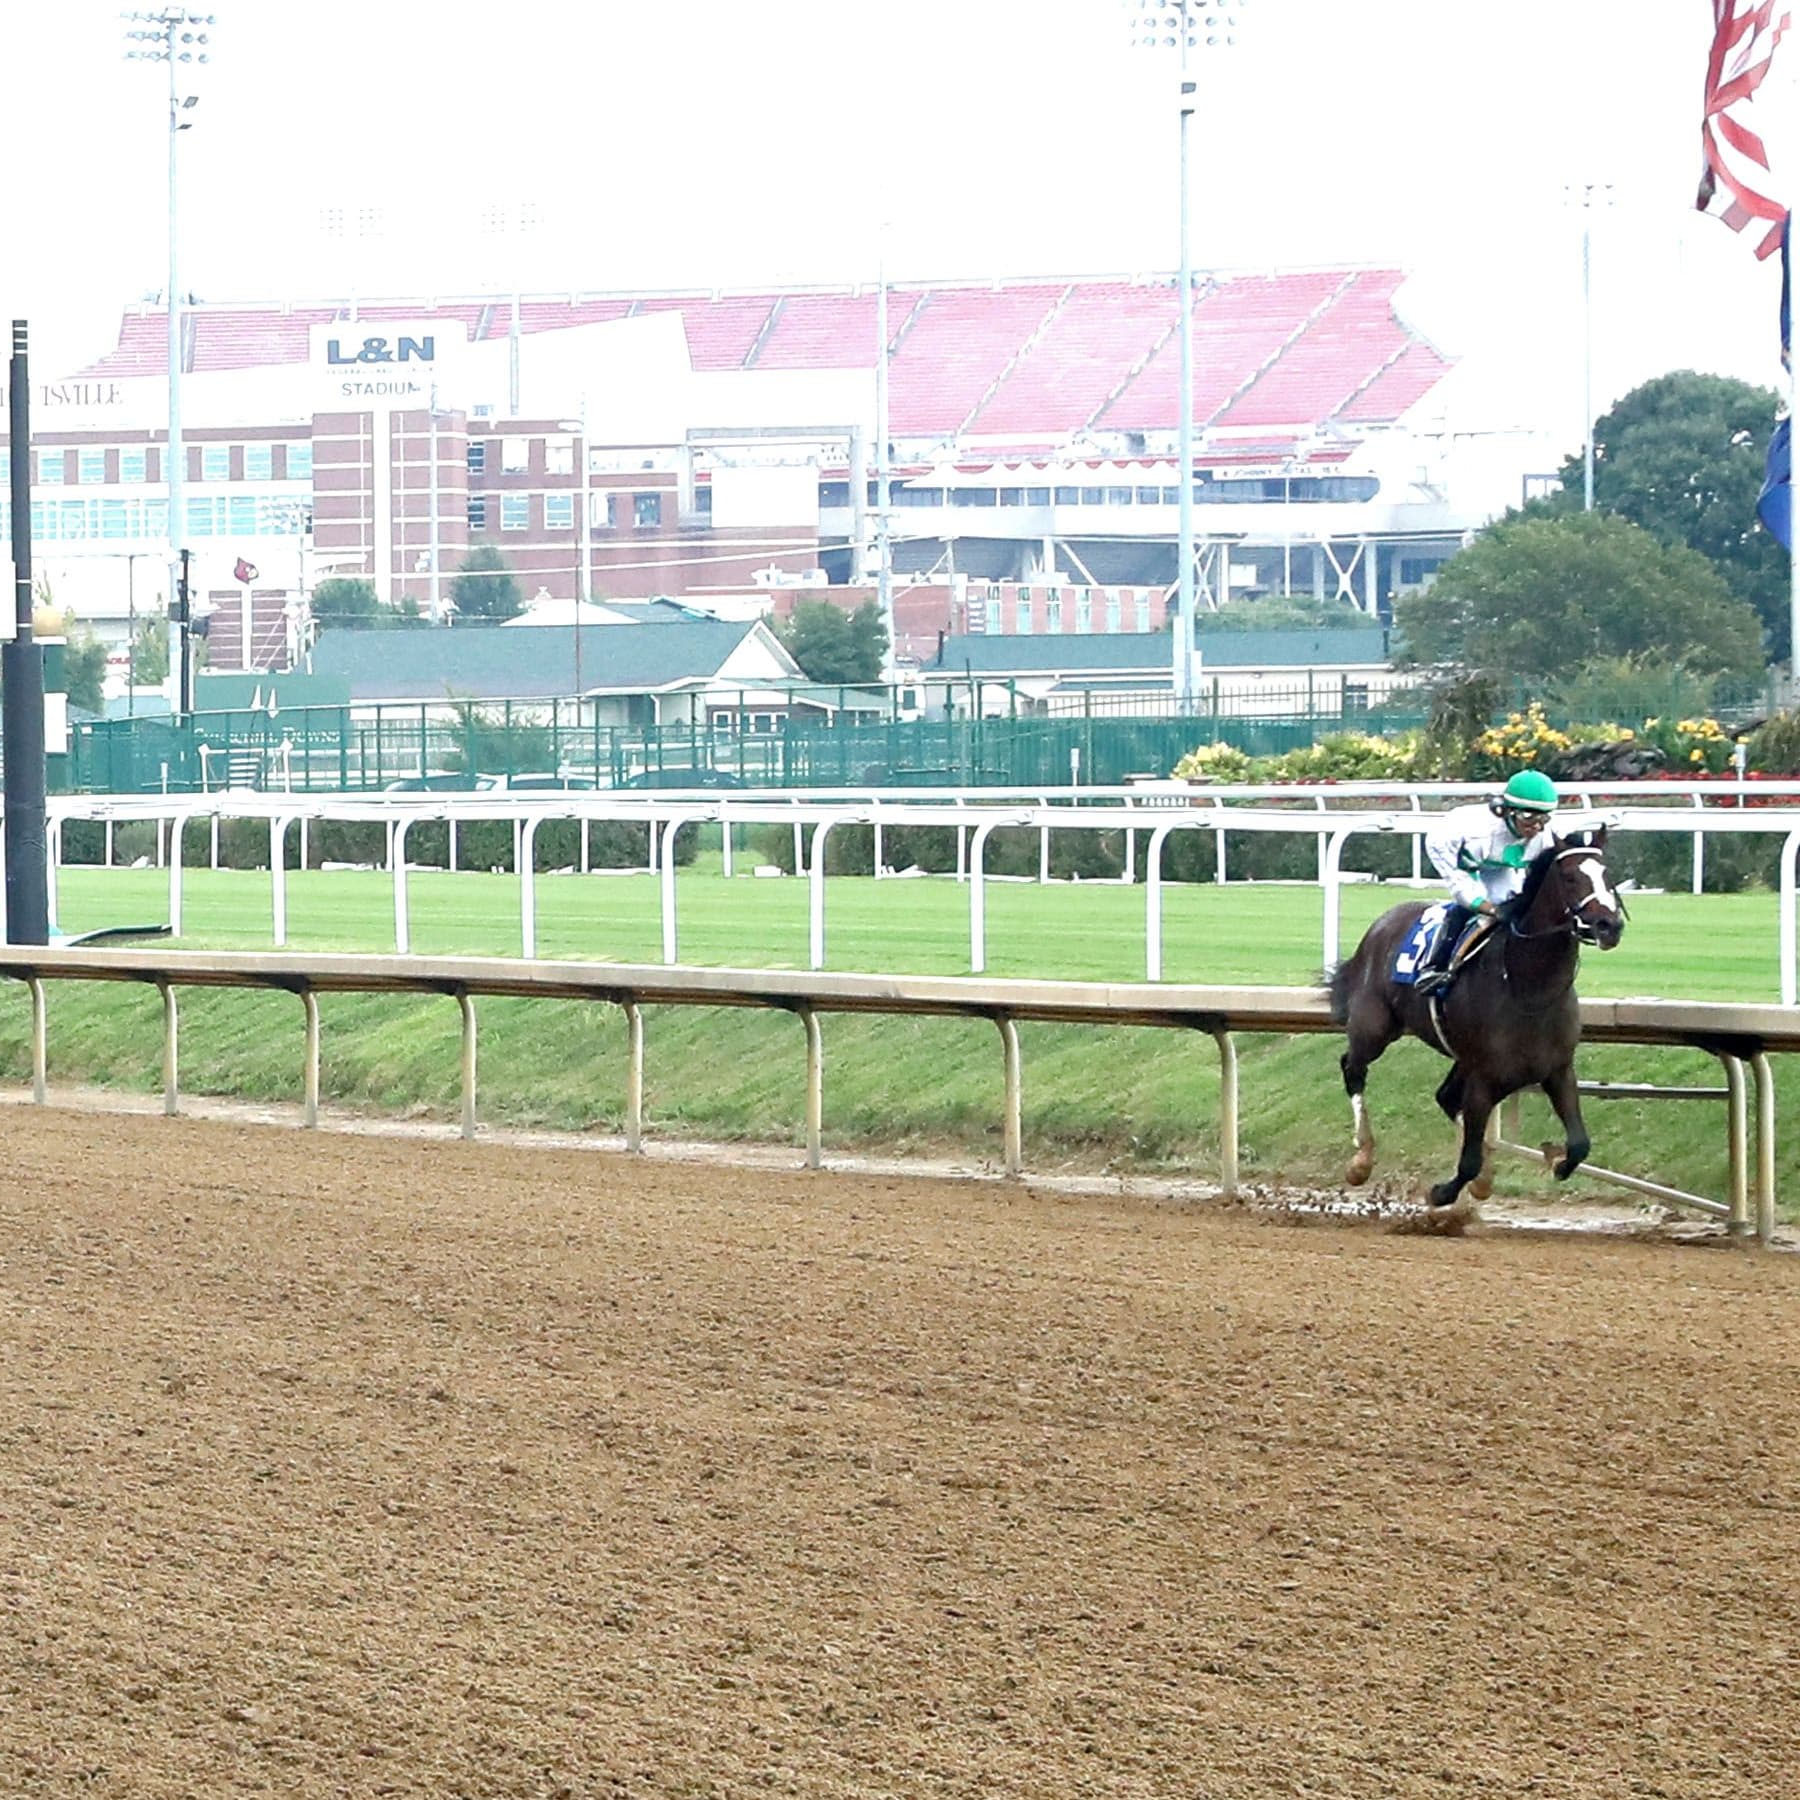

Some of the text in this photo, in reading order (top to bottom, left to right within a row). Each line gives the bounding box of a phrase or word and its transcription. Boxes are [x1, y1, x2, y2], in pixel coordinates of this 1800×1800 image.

[327, 336, 434, 364] L&N
[0, 383, 124, 407] LISVILLE
[342, 382, 421, 396] STADIUM
